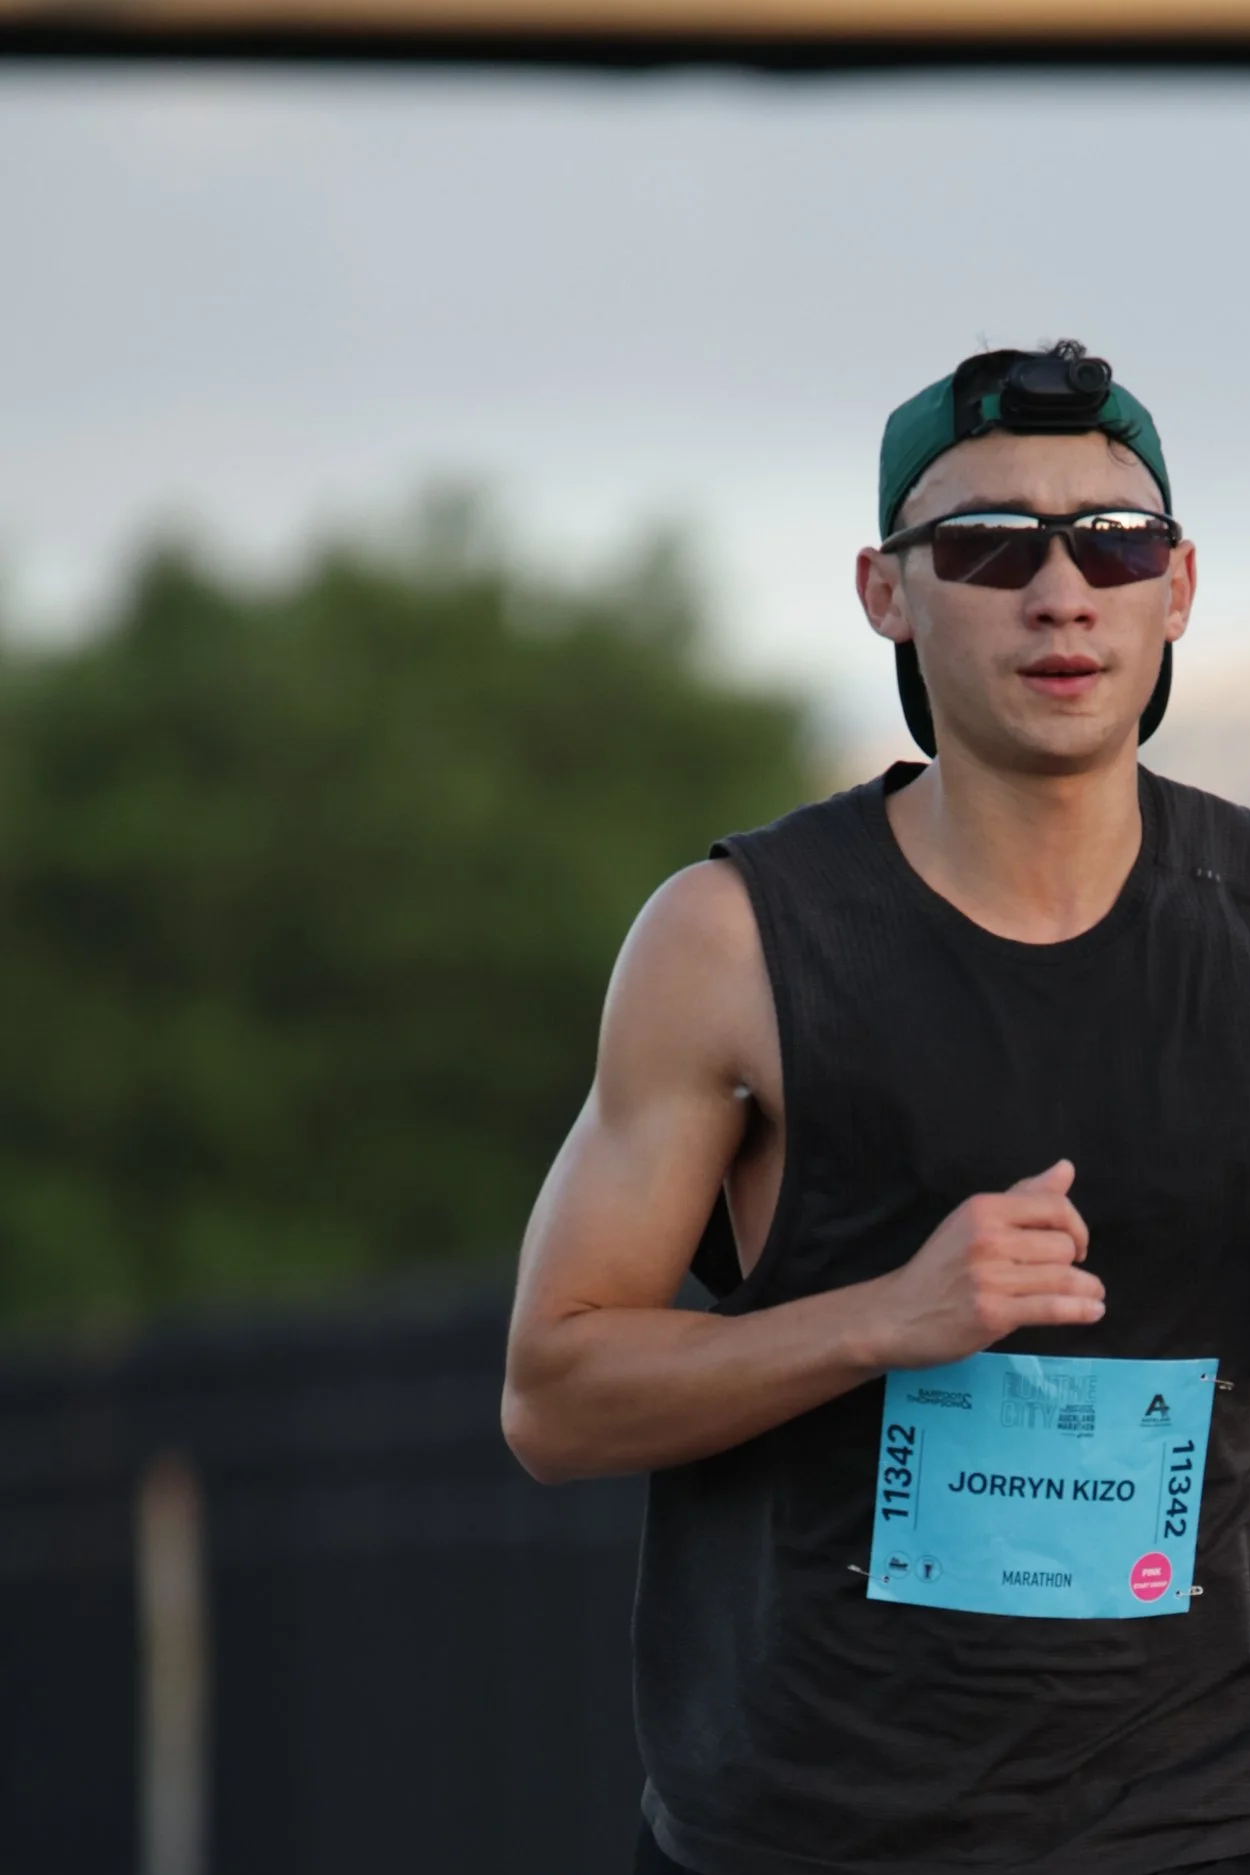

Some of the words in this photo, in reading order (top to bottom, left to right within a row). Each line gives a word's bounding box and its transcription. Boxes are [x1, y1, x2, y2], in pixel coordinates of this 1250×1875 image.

[1000, 1400, 1058, 1429] CITY
[882, 1423, 916, 1522] 11342
[948, 1471, 1064, 1500] JORRYN
[1072, 1479, 1136, 1502] KIZO
[1163, 1439, 1195, 1539] 11342
[1002, 1570, 1072, 1588] MARATHON
